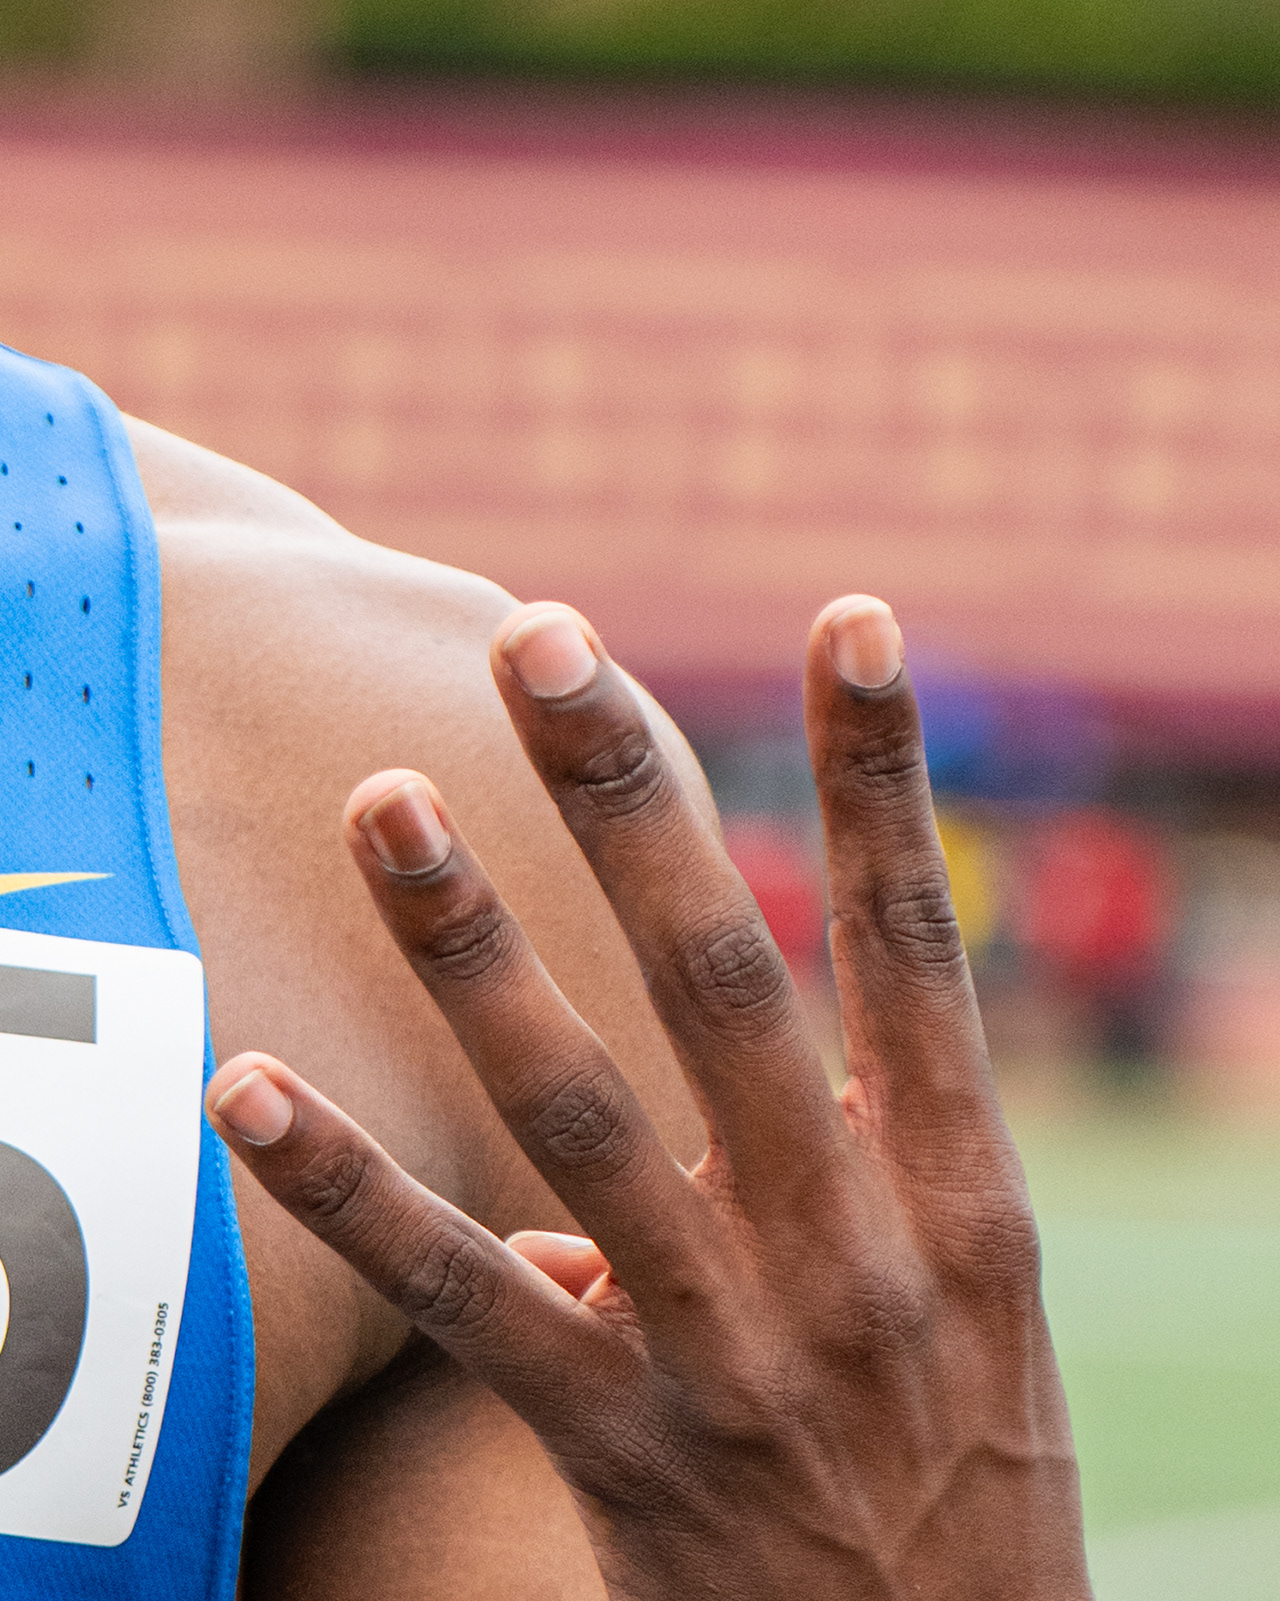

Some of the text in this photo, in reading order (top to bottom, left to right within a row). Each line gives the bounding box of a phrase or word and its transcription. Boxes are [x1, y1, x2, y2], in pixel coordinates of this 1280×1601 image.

[117, 1302, 169, 1509] VS ATHLETICS (800) 383-0305
